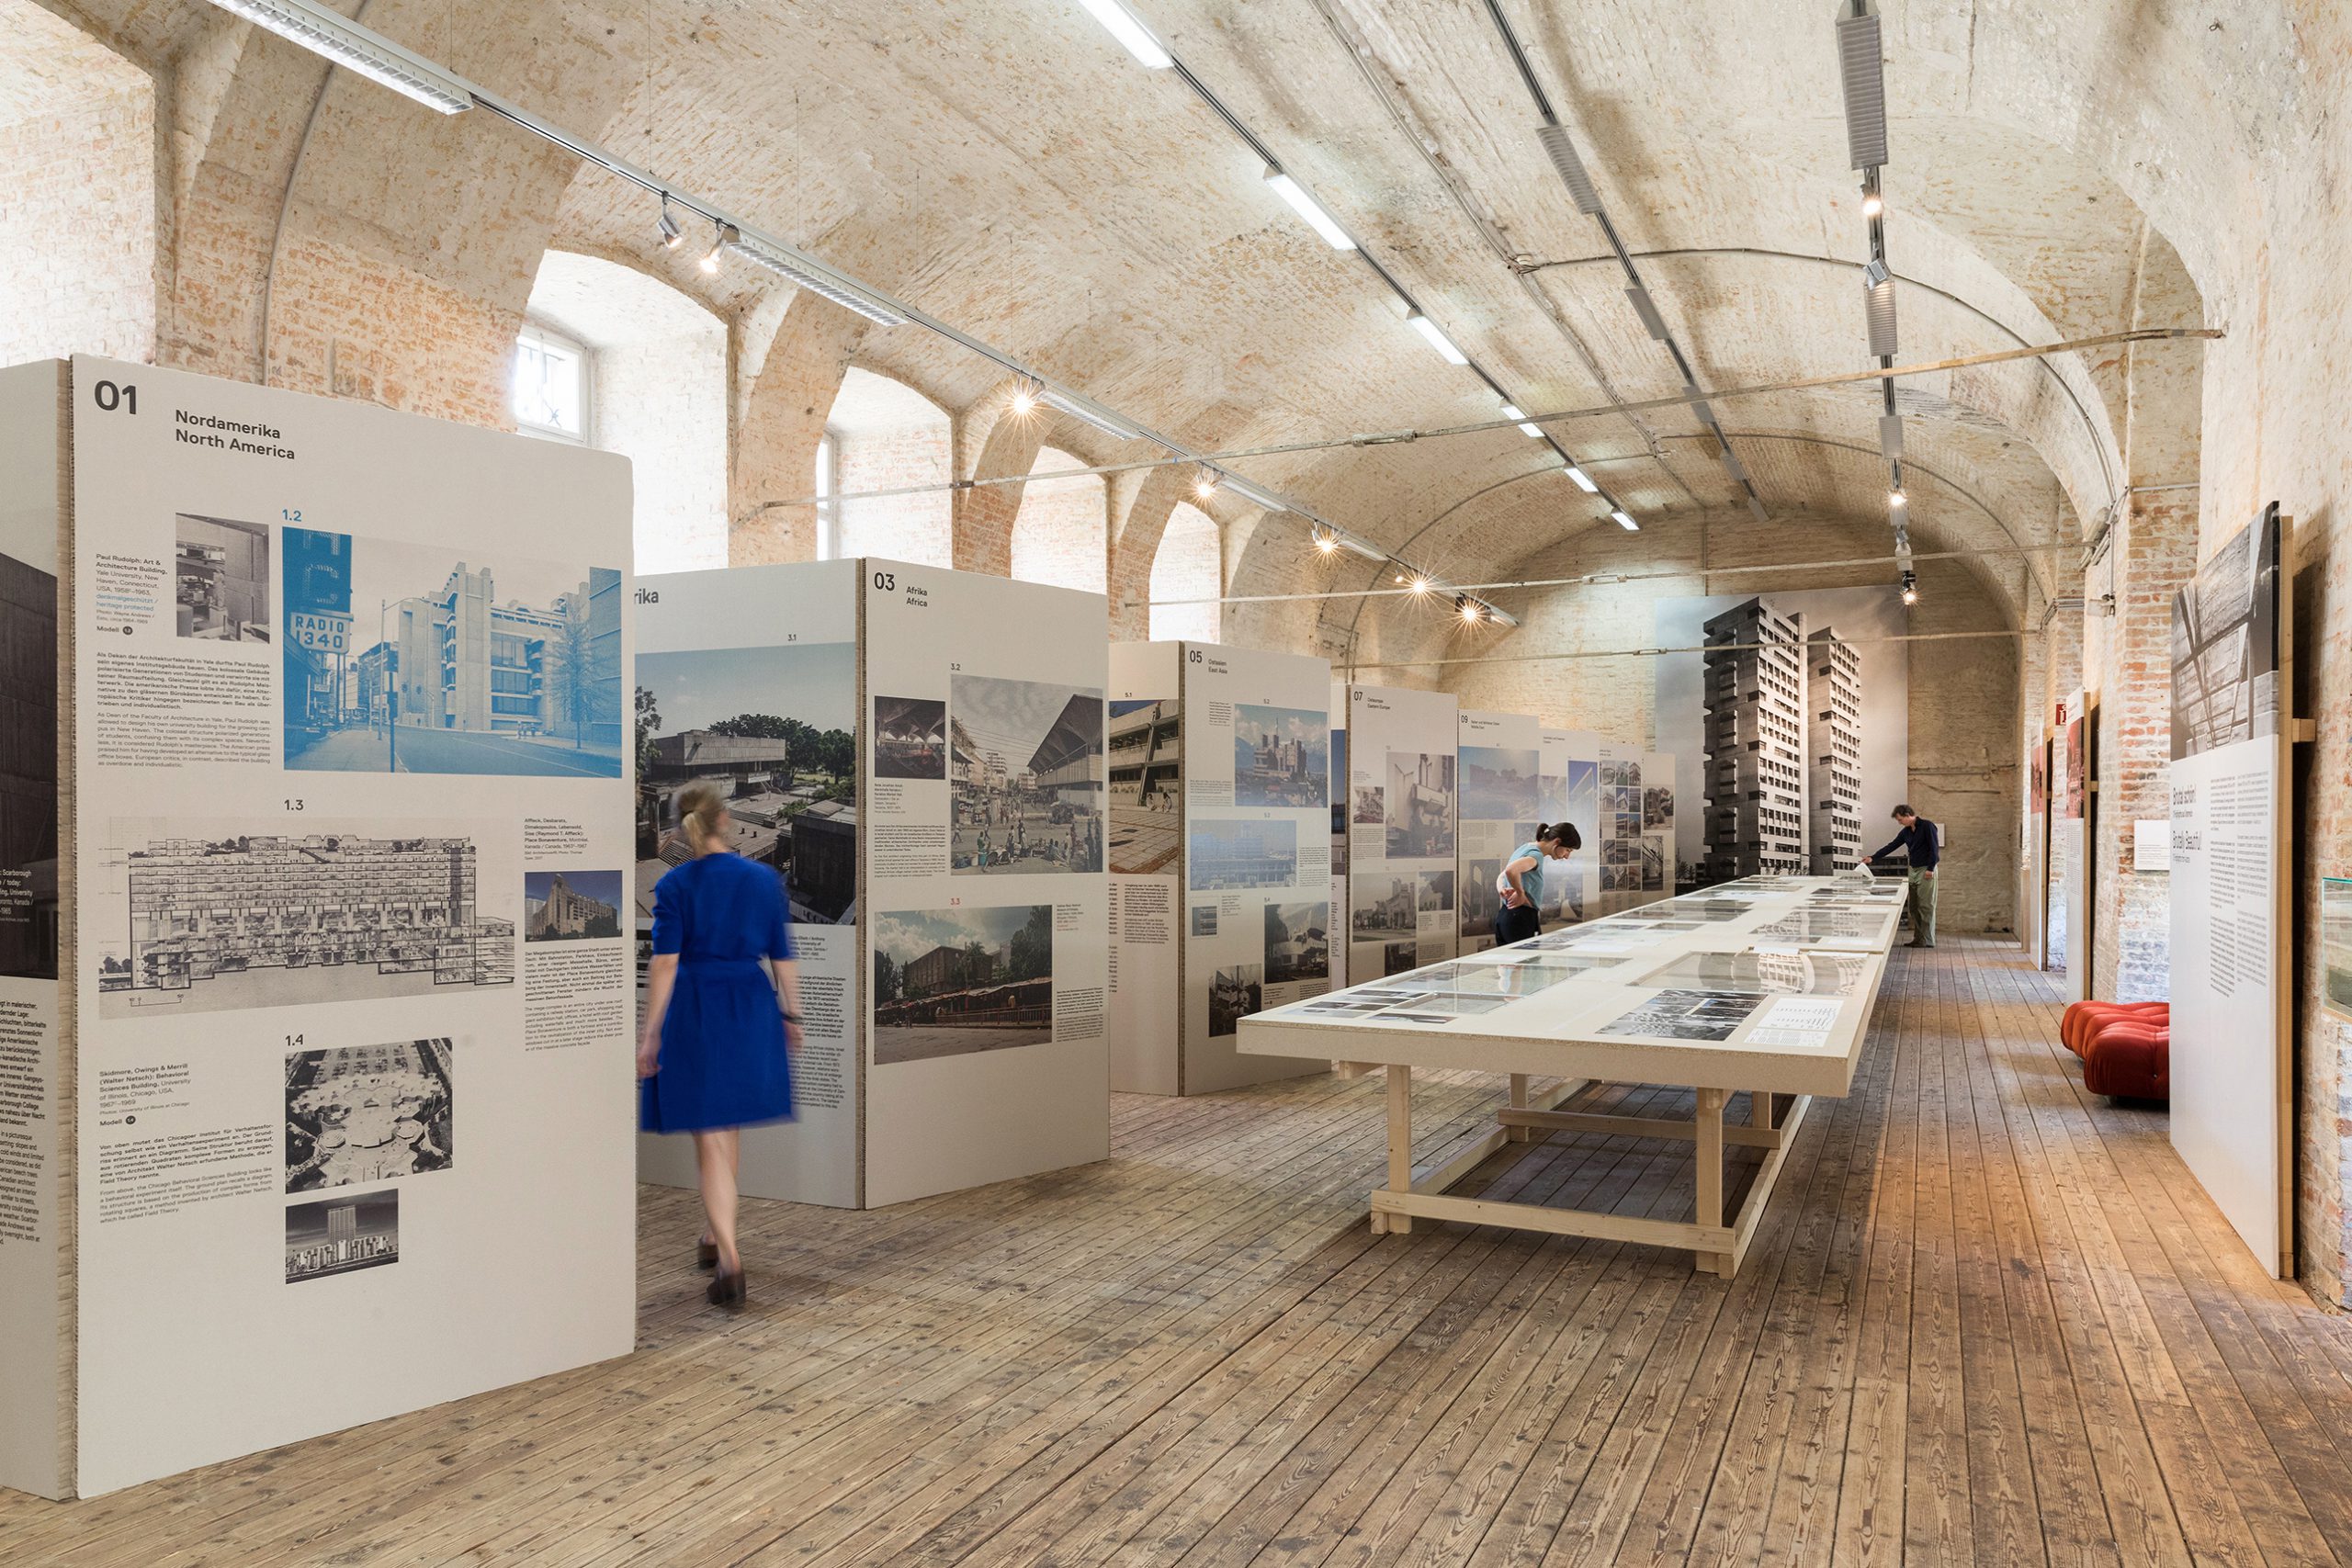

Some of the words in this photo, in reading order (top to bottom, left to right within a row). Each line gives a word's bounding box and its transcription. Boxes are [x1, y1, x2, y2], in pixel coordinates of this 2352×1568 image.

[94, 380, 137, 415] 01
[175, 409, 281, 439] Nordamerika
[175, 429, 224, 448] North
[230, 438, 295, 459] America
[282, 509, 302, 522] 1.2
[112, 555, 141, 564] Rudolph:
[96, 562, 137, 571] Architecture
[111, 571, 143, 581] University,
[874, 572, 895, 591] 03
[119, 580, 159, 589] Connecticut,
[906, 586, 928, 597] Afrika
[906, 597, 928, 608] Africa
[295, 615, 344, 633] RADIO
[296, 630, 343, 649] 1340
[1189, 649, 1202, 663] 05
[950, 663, 961, 671] 3.2
[1354, 691, 1363, 701] 07
[1461, 715, 1468, 723] 09
[284, 799, 304, 811] 1.3
[2, 869, 32, 878] Scarborough
[285, 1034, 303, 1046] 1.4
[156, 1071, 189, 1079] Behavioral
[99, 1084, 130, 1093] Sciences
[169, 1136, 230, 1148] Verhaltensexperiment
[114, 1161, 148, 1169] rotierenden
